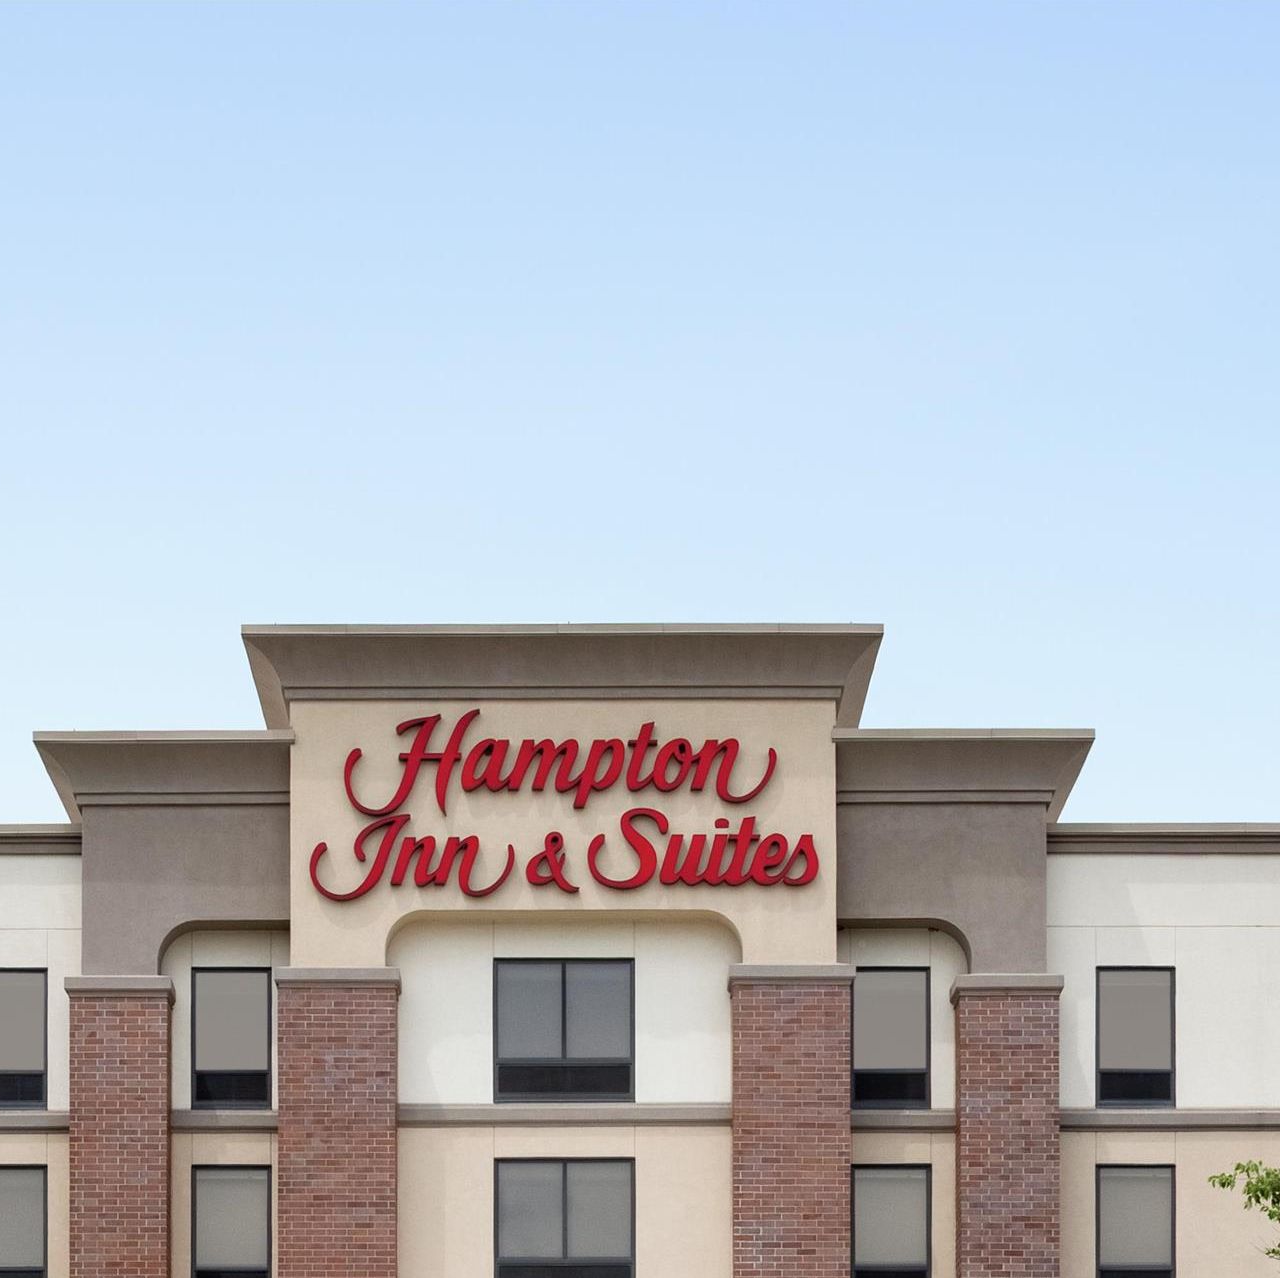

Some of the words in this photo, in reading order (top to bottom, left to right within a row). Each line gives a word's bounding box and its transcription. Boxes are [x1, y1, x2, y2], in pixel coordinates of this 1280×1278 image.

[343, 708, 777, 816] Hampton
[309, 813, 516, 901] Inn
[525, 831, 581, 894] &
[587, 807, 820, 890] Suites
